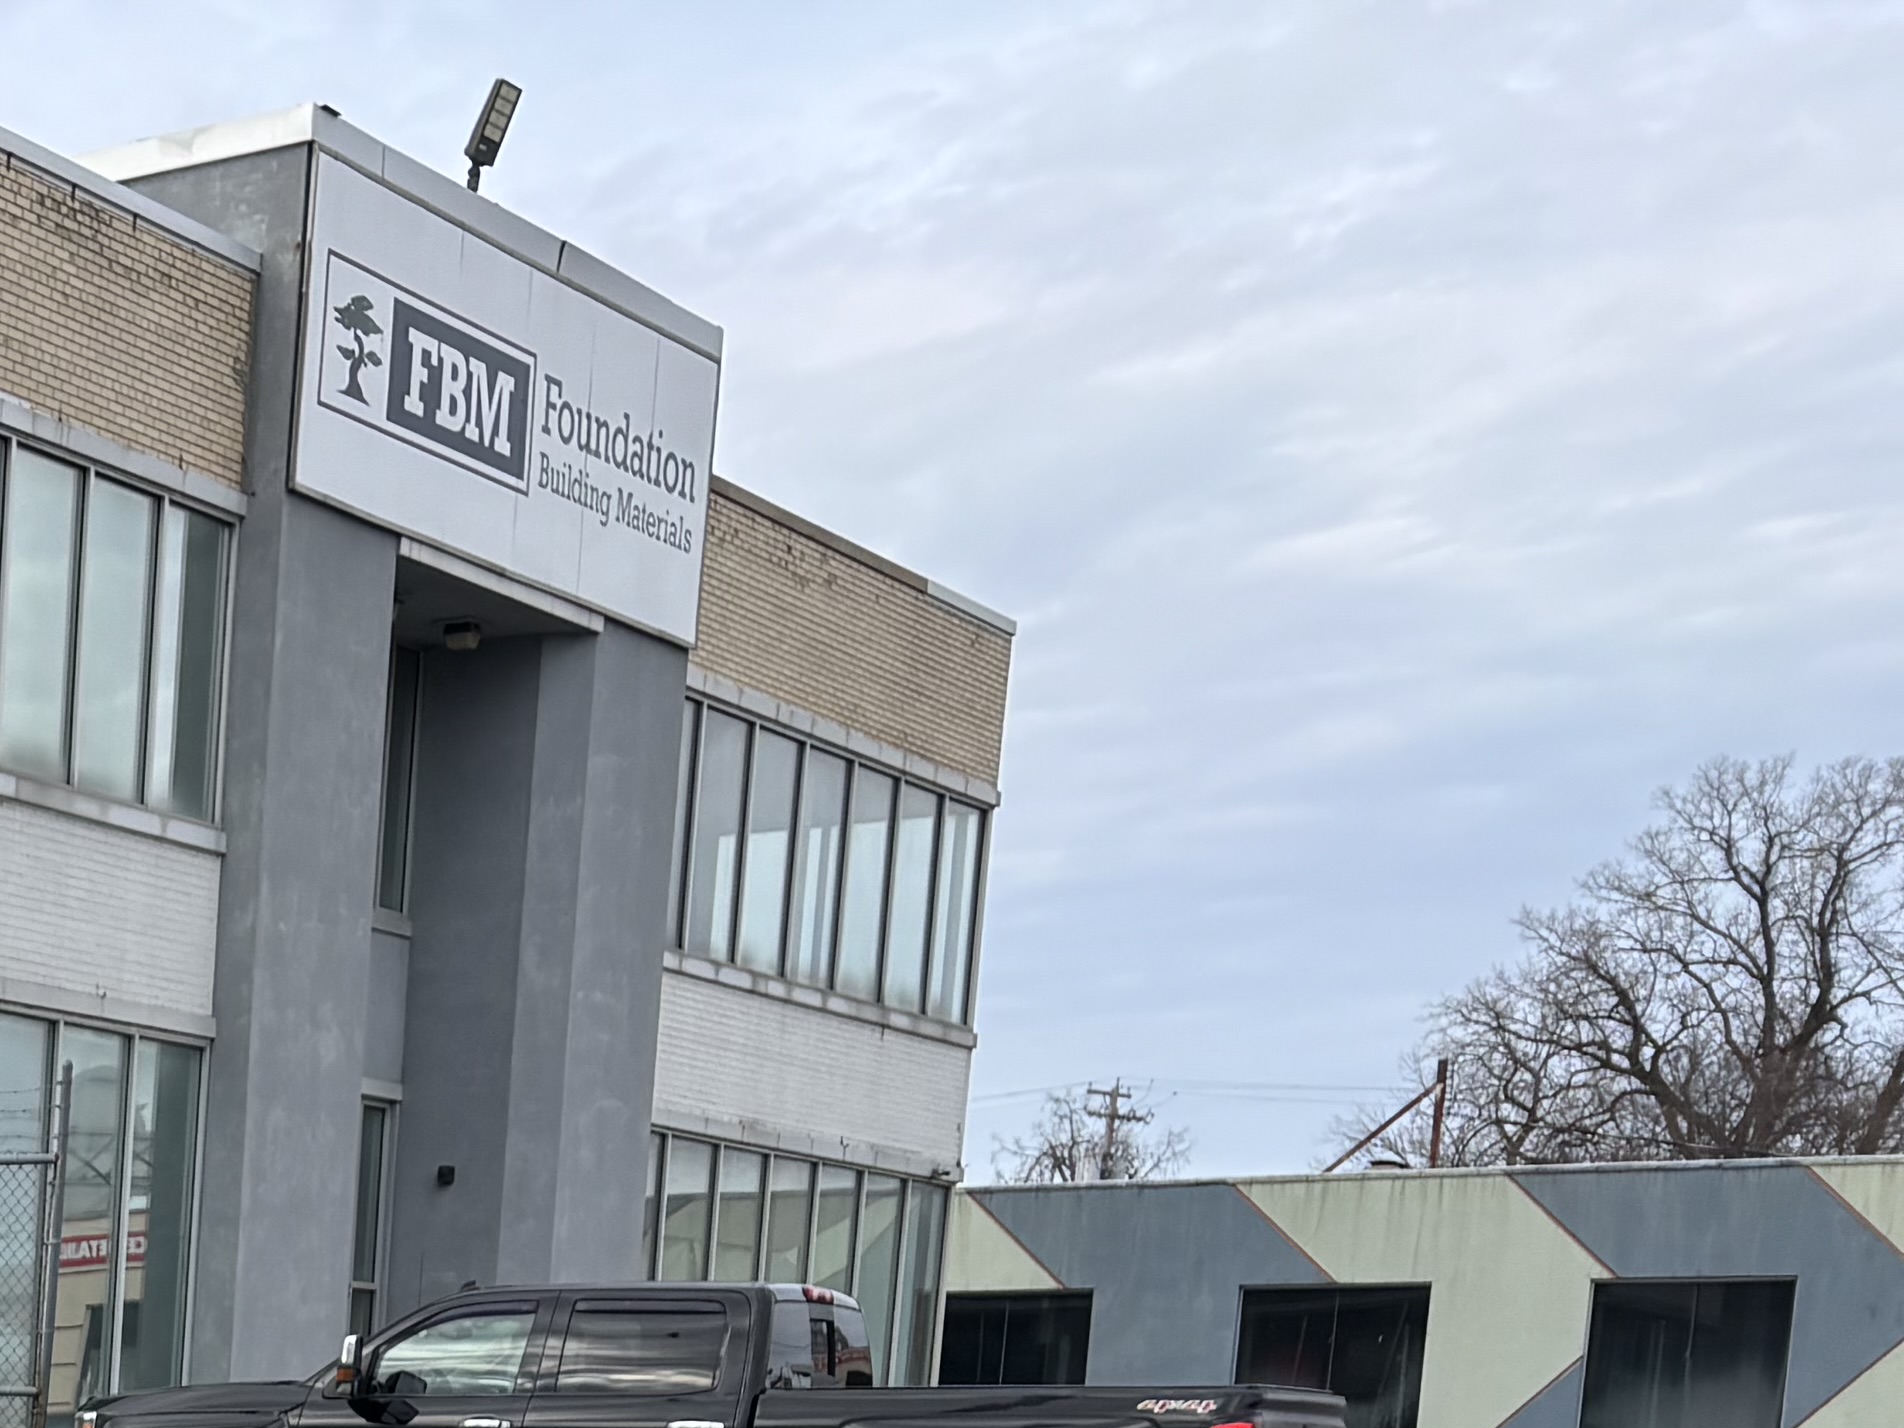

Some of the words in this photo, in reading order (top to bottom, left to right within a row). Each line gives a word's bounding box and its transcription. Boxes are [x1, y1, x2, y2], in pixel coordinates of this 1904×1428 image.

[404, 326, 517, 458] FBM
[540, 373, 696, 505] Foundation
[537, 451, 612, 527] Building
[615, 491, 693, 554] Materials
